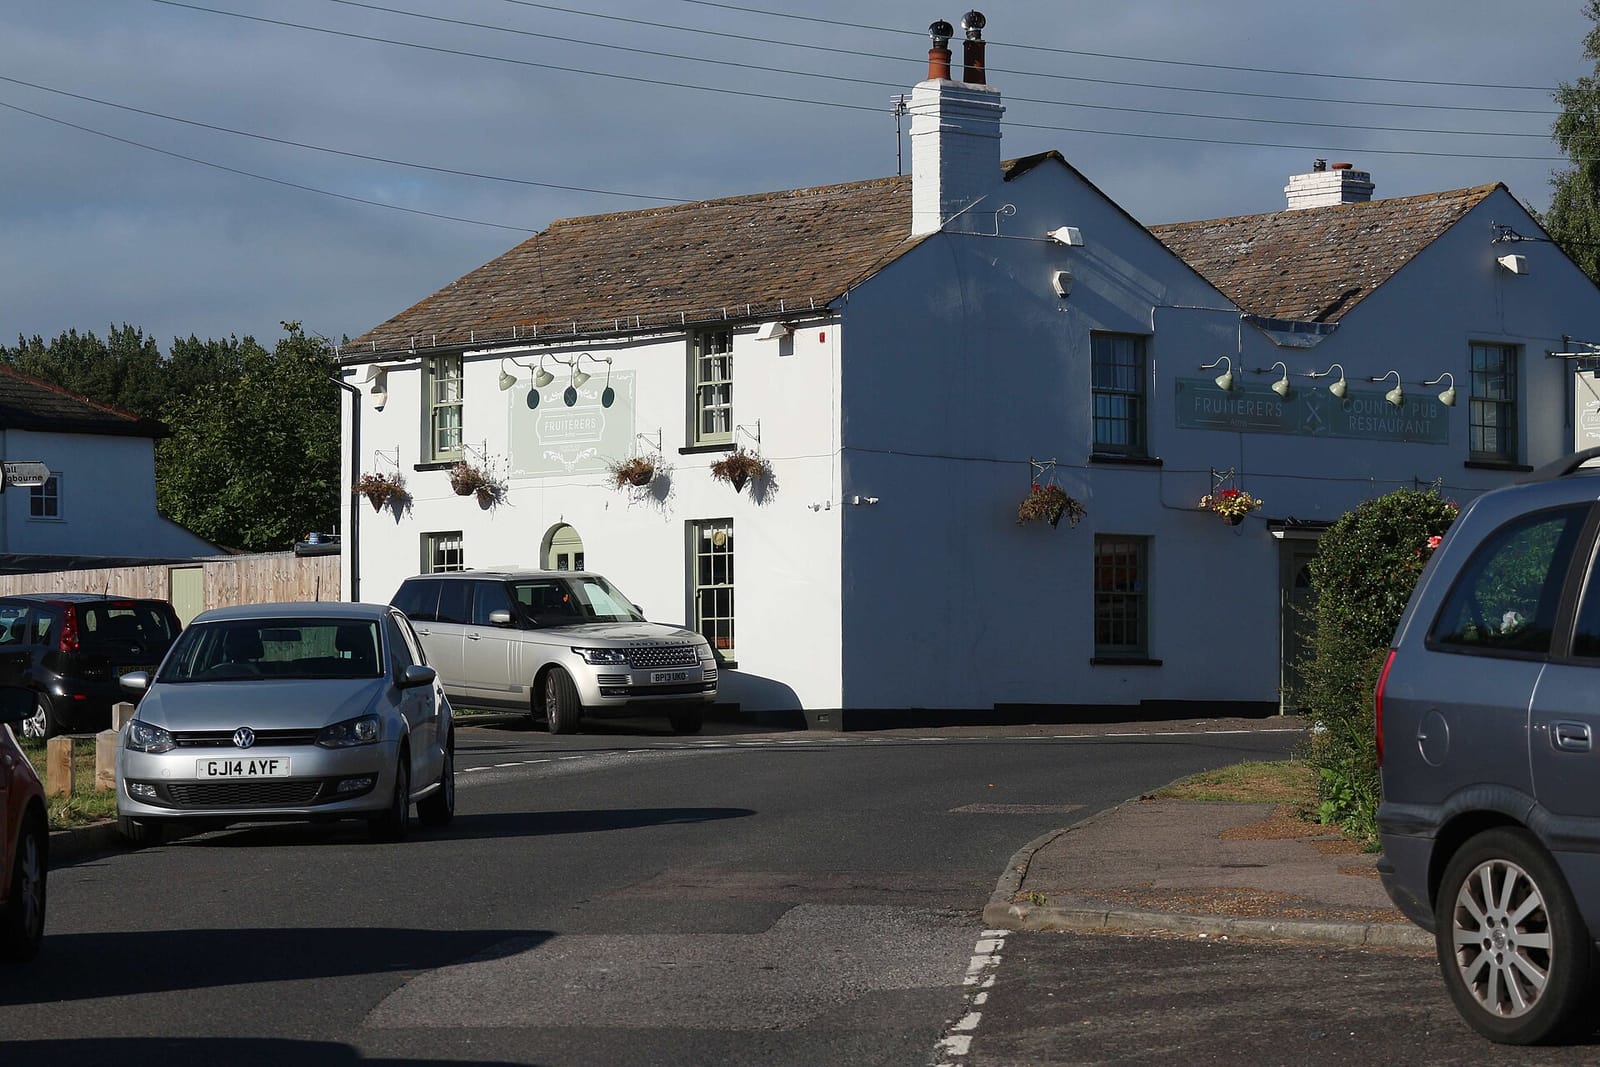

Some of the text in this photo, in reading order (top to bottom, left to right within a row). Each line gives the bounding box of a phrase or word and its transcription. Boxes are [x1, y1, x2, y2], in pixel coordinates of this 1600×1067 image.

[1194, 397, 1282, 417] FRUITERERS
[1342, 398, 1437, 418] COUNTRY PUB
[544, 418, 596, 432] FRUITERERS
[1349, 416, 1431, 434] RESTAURANT
[656, 673, 671, 681] BP13
[208, 760, 279, 776] GJ14 AYF
